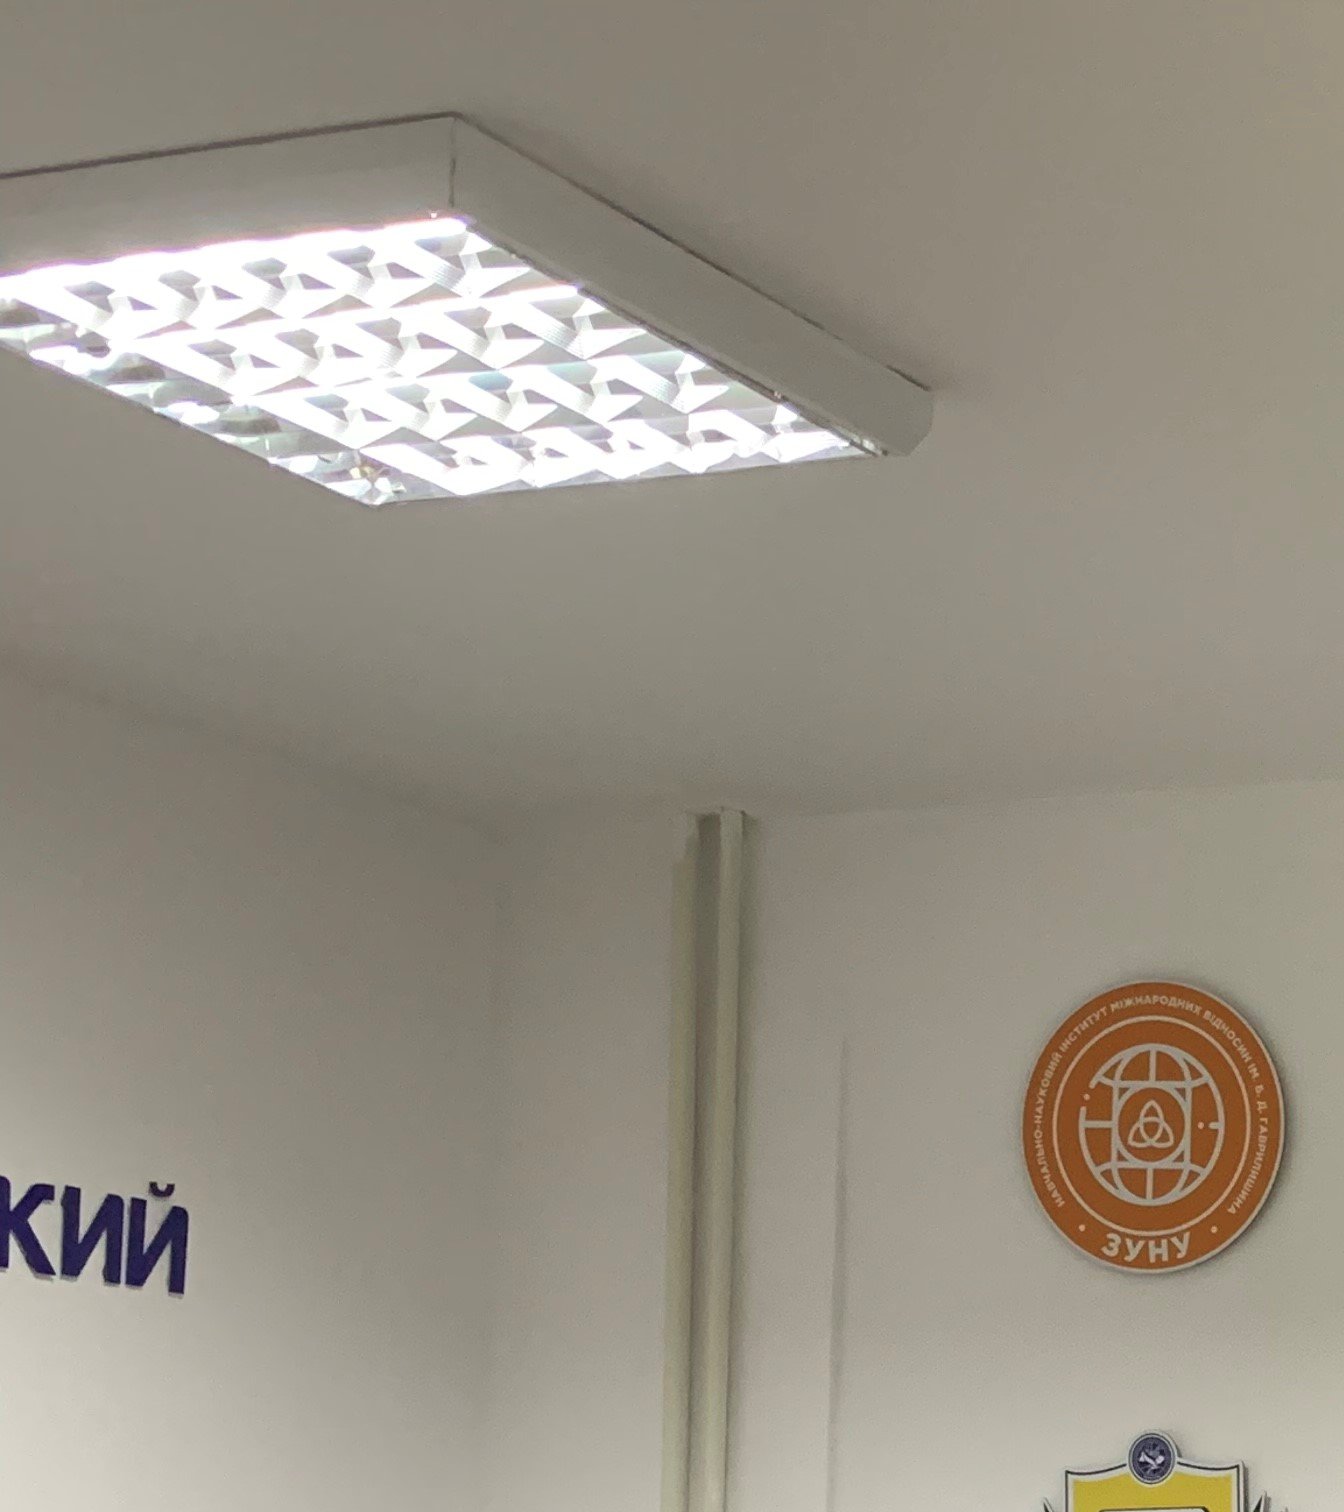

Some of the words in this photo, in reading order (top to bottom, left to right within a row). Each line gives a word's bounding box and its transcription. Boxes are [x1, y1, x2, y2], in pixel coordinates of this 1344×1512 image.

[1033, 1051, 1065, 1208] НАВЧАЛЬНО-НАУКОВИЙ
[1058, 1005, 1108, 1053] ІНСТИТУТ
[1110, 995, 1203, 1016] МІЖНАРОДНИХ
[1203, 1010, 1252, 1065] ВІДНОСИН
[0, 1176, 189, 1297] КИЙ
[1101, 1231, 1191, 1263] ЗУНУ
